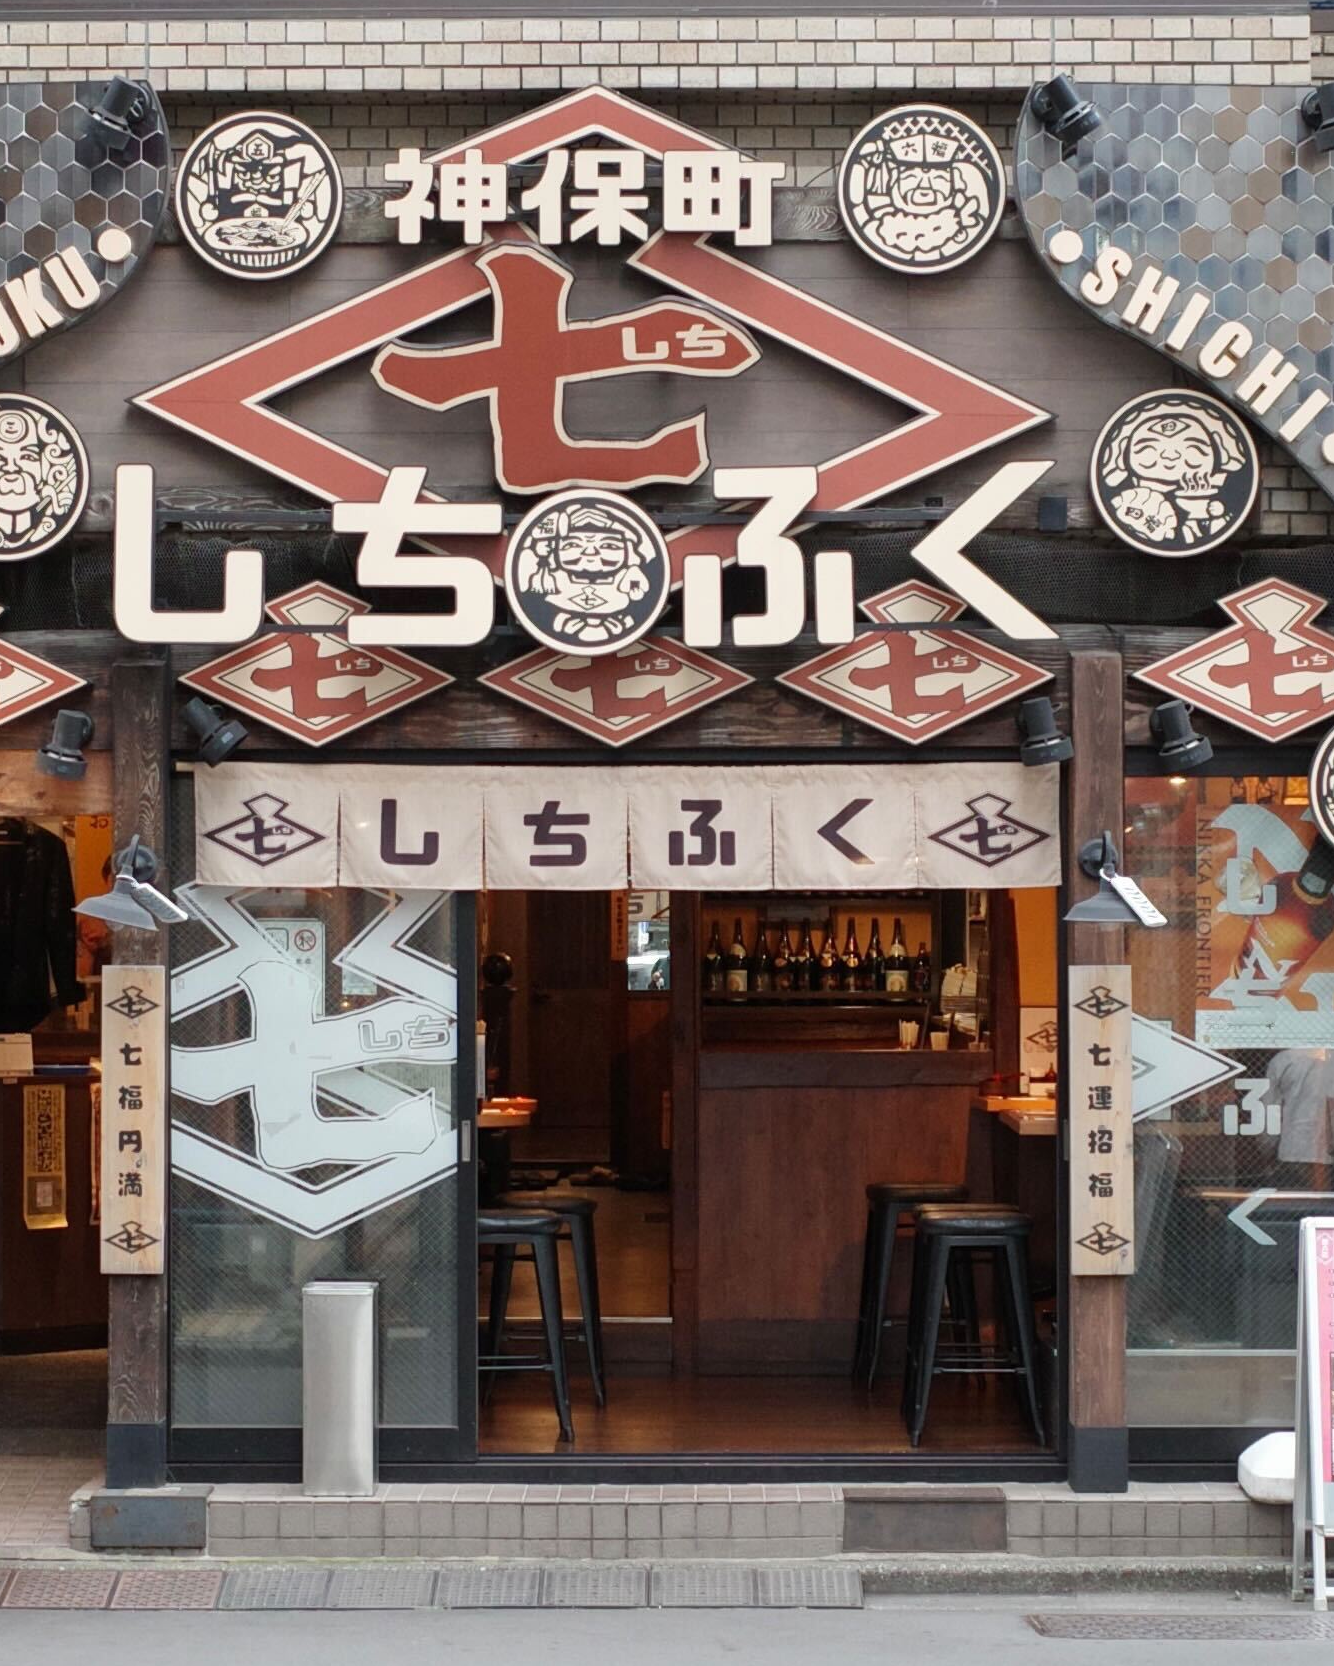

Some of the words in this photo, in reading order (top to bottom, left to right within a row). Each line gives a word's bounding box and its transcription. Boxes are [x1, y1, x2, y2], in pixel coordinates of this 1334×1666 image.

[383, 147, 786, 248] 神保町
[370, 242, 763, 496] 七
[622, 324, 729, 363] しち
[1079, 246, 1333, 445] SHICHI
[113, 460, 1061, 649] しちふく
[335, 657, 372, 672] しち
[635, 657, 670, 671] しち
[932, 656, 968, 670] しち
[1292, 652, 1328, 668] しち
[380, 798, 875, 867] しちふく
[1196, 818, 1213, 887] NIKKA
[1196, 894, 1213, 999] FRONTIER
[118, 1042, 144, 1198] 七福円満
[1087, 1042, 1114, 1198] 七運招福
